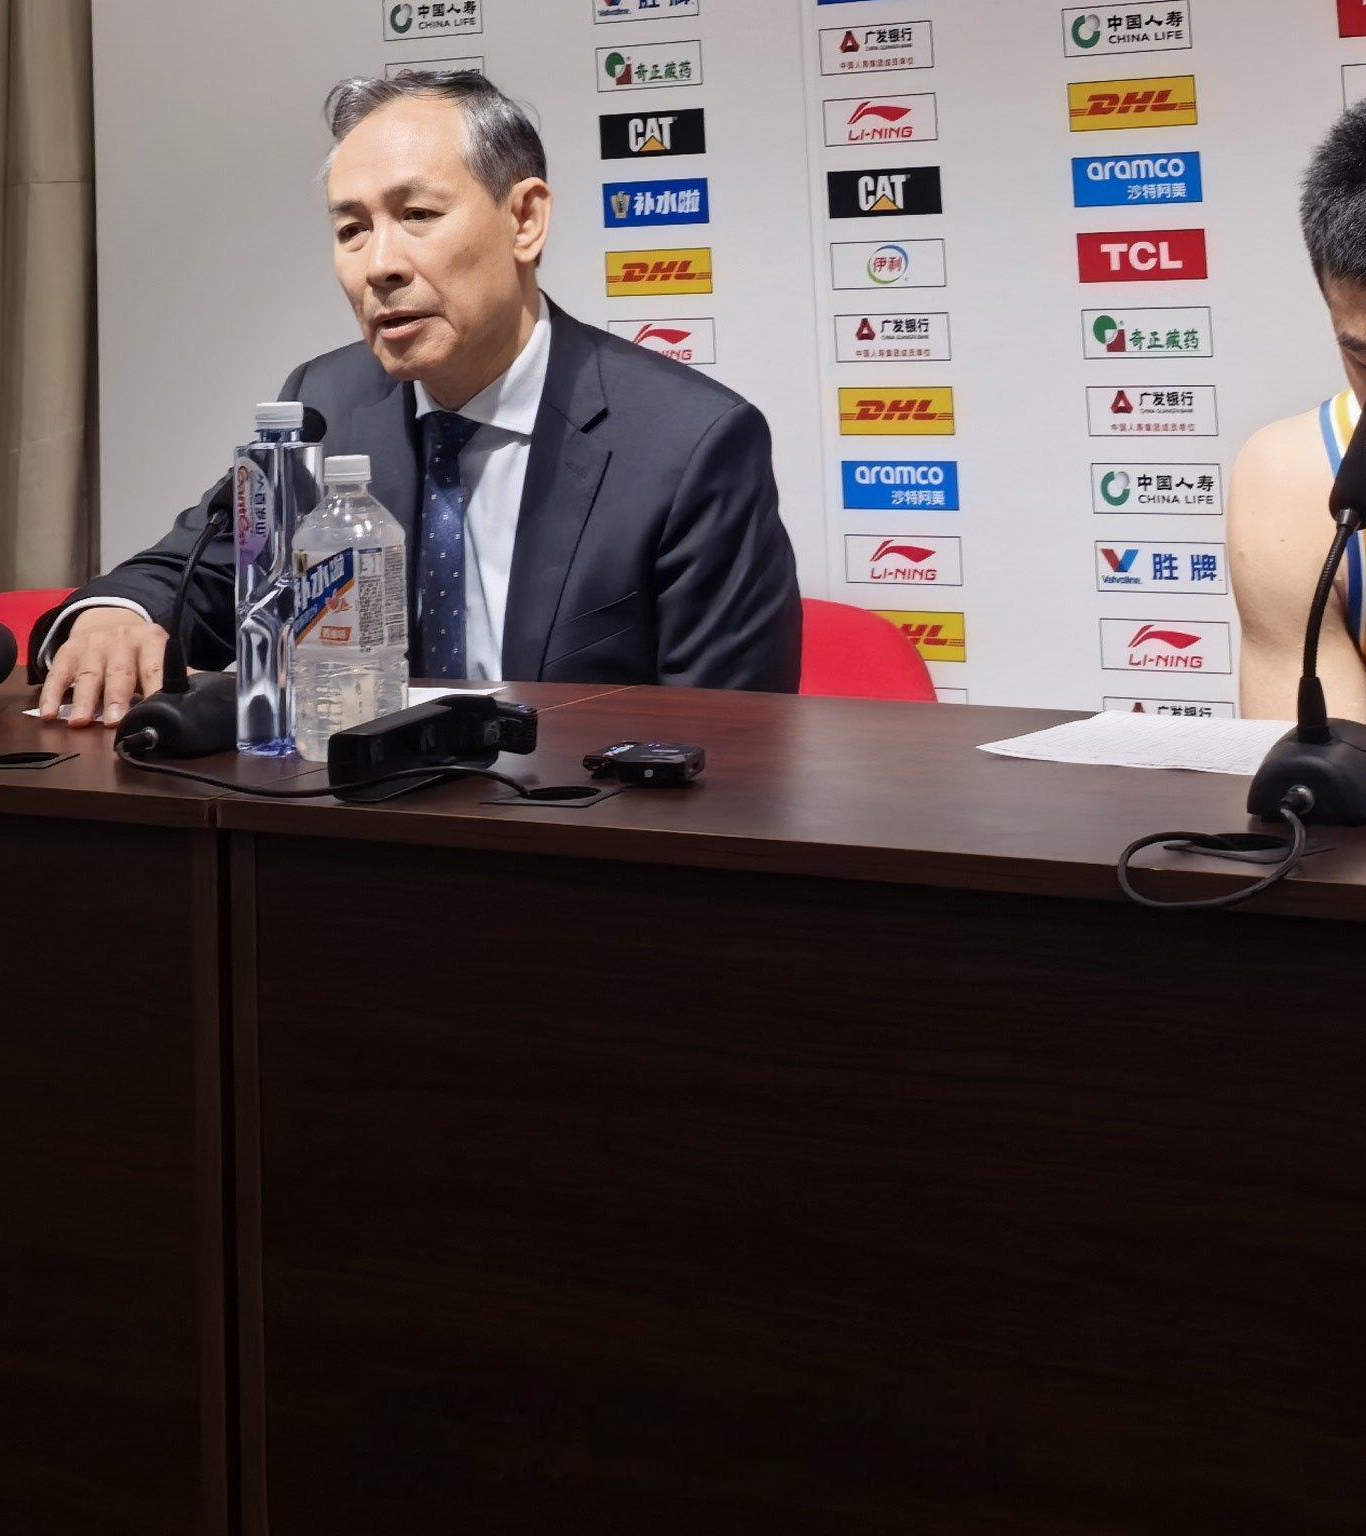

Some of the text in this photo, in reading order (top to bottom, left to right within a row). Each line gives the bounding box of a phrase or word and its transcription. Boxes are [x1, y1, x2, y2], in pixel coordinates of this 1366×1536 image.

[418, 1, 476, 18] 中国人寿
[419, 17, 476, 29] CHINA LIFE
[1107, 11, 1183, 32] 中国人寿
[865, 28, 912, 44] 广发银行
[1109, 30, 1183, 44] CHINA LIFE
[1086, 90, 1178, 116] DHL
[629, 117, 673, 152] CAT
[849, 126, 913, 140] LI-NING
[1087, 158, 1185, 180] aramco
[858, 175, 906, 210] CAT
[1128, 183, 1187, 200] 沙特阿美
[633, 190, 700, 215] 补水啦
[873, 257, 902, 272] 伊利
[1101, 242, 1183, 270] TCL
[620, 260, 697, 282] DHL
[881, 318, 929, 333] 广发银行
[1139, 392, 1193, 406] 广发银行
[854, 400, 937, 420] DHL
[855, 466, 943, 485] aramco
[1137, 474, 1213, 491] 中国人寿
[891, 490, 945, 505] 沙特阿美
[1138, 494, 1213, 504] CHINA LIFE
[871, 568, 937, 580] LI-NING
[1153, 554, 1217, 581] 胜牌
[899, 623, 947, 646] HL
[1129, 654, 1203, 668] LI-NING
